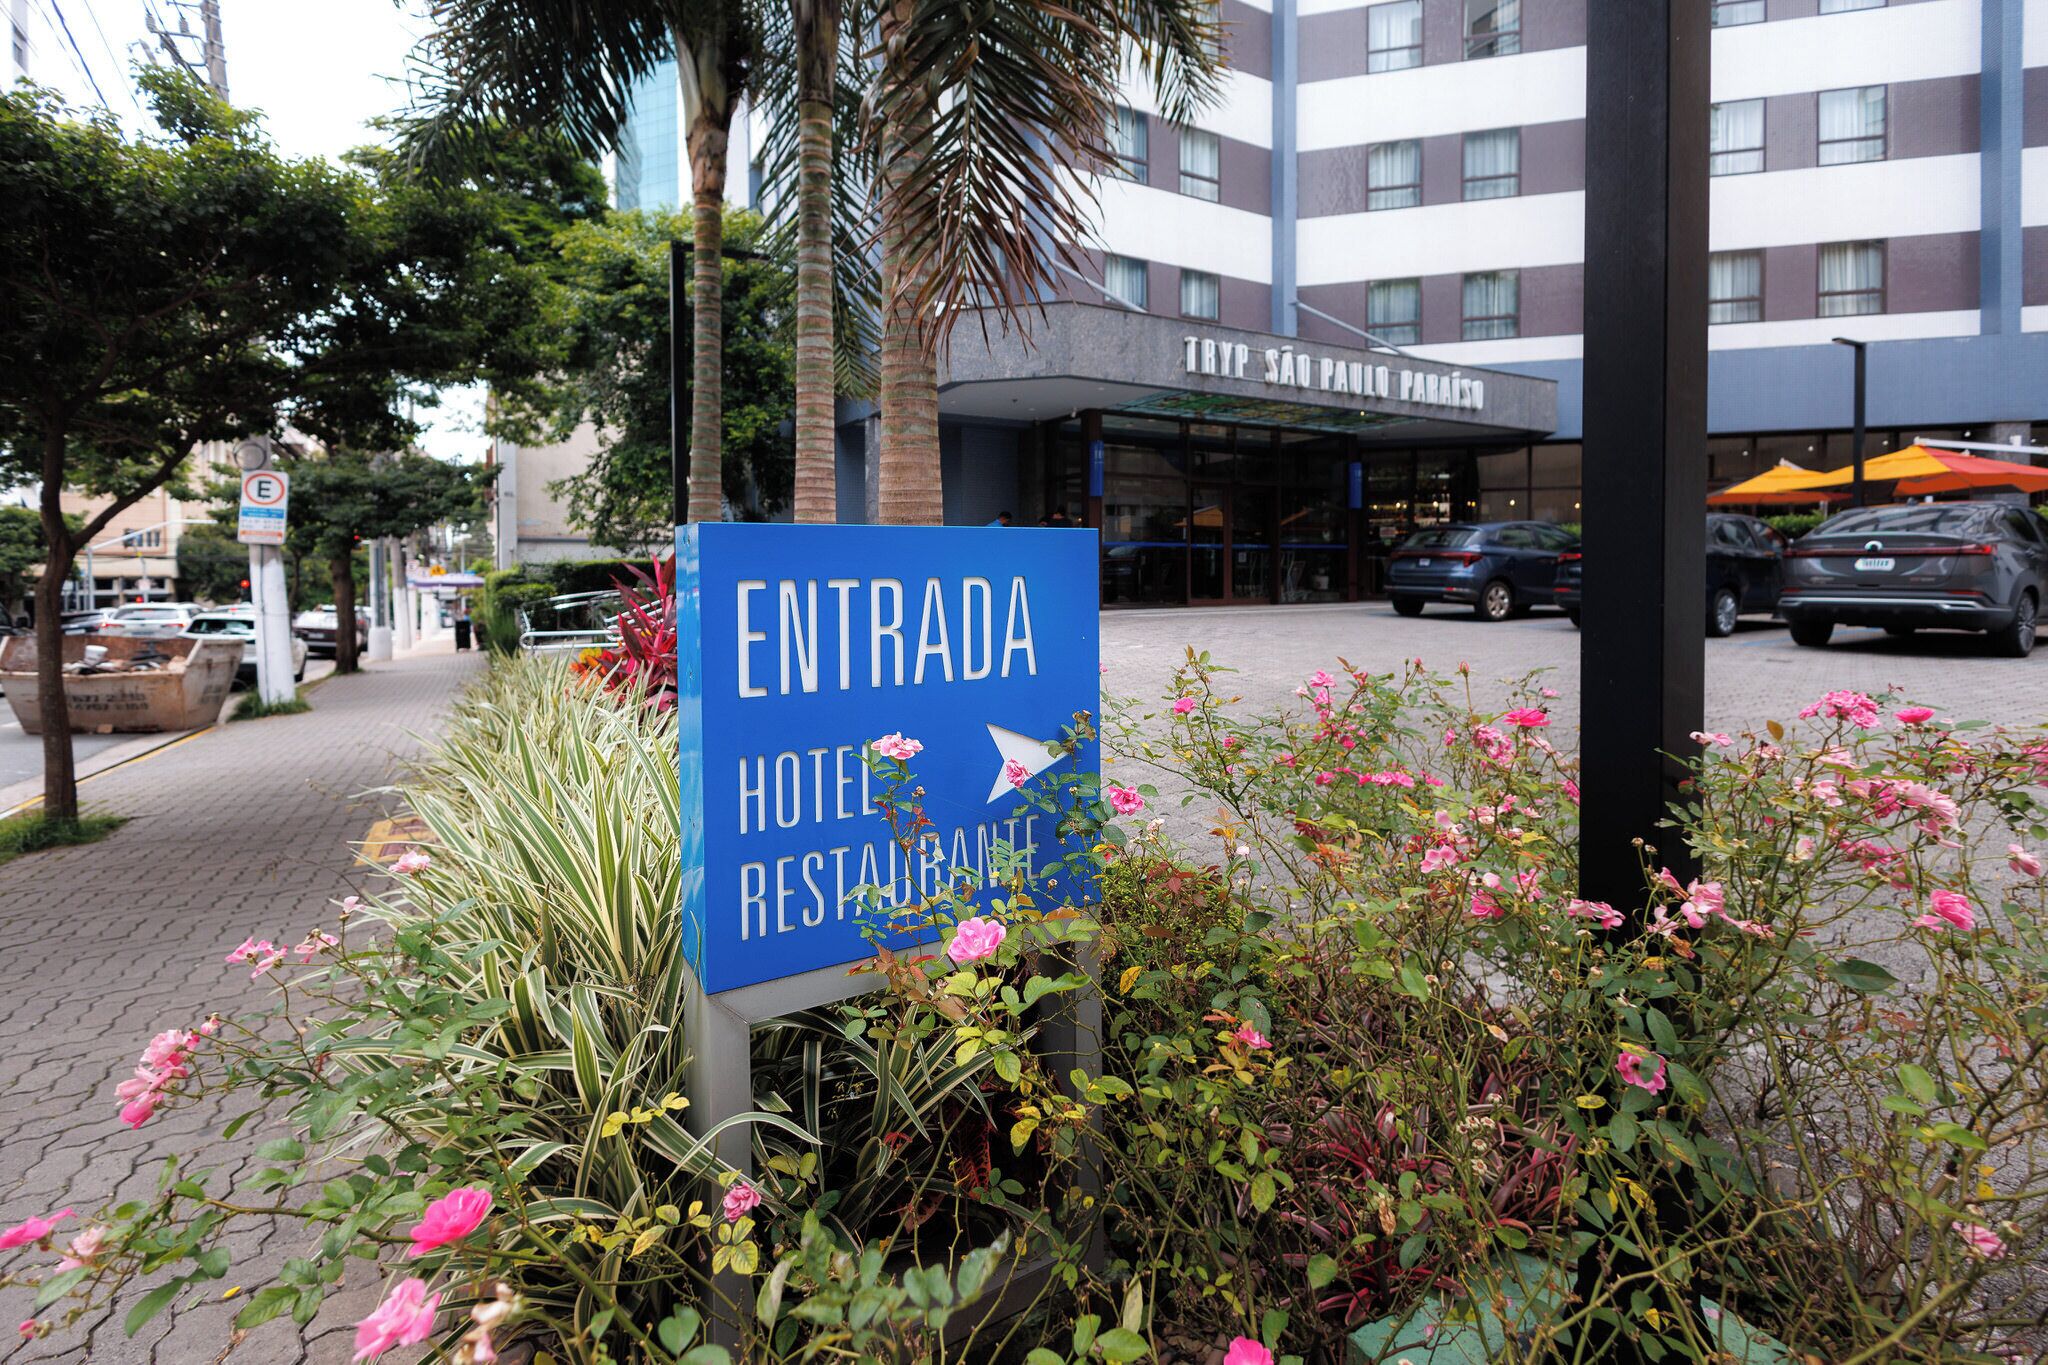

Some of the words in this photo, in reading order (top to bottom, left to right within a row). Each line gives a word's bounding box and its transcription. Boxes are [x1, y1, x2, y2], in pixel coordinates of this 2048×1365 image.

[1184, 336, 1248, 378] TRYP
[1264, 346, 1310, 388] SÃO
[1320, 358, 1389, 398] PAULO
[1400, 371, 1484, 410] PARAÍSO
[257, 480, 272, 498] E
[737, 576, 1037, 699] ENTRADA
[738, 743, 880, 835] HOTEL
[740, 814, 1040, 942] RESTAURANTE
